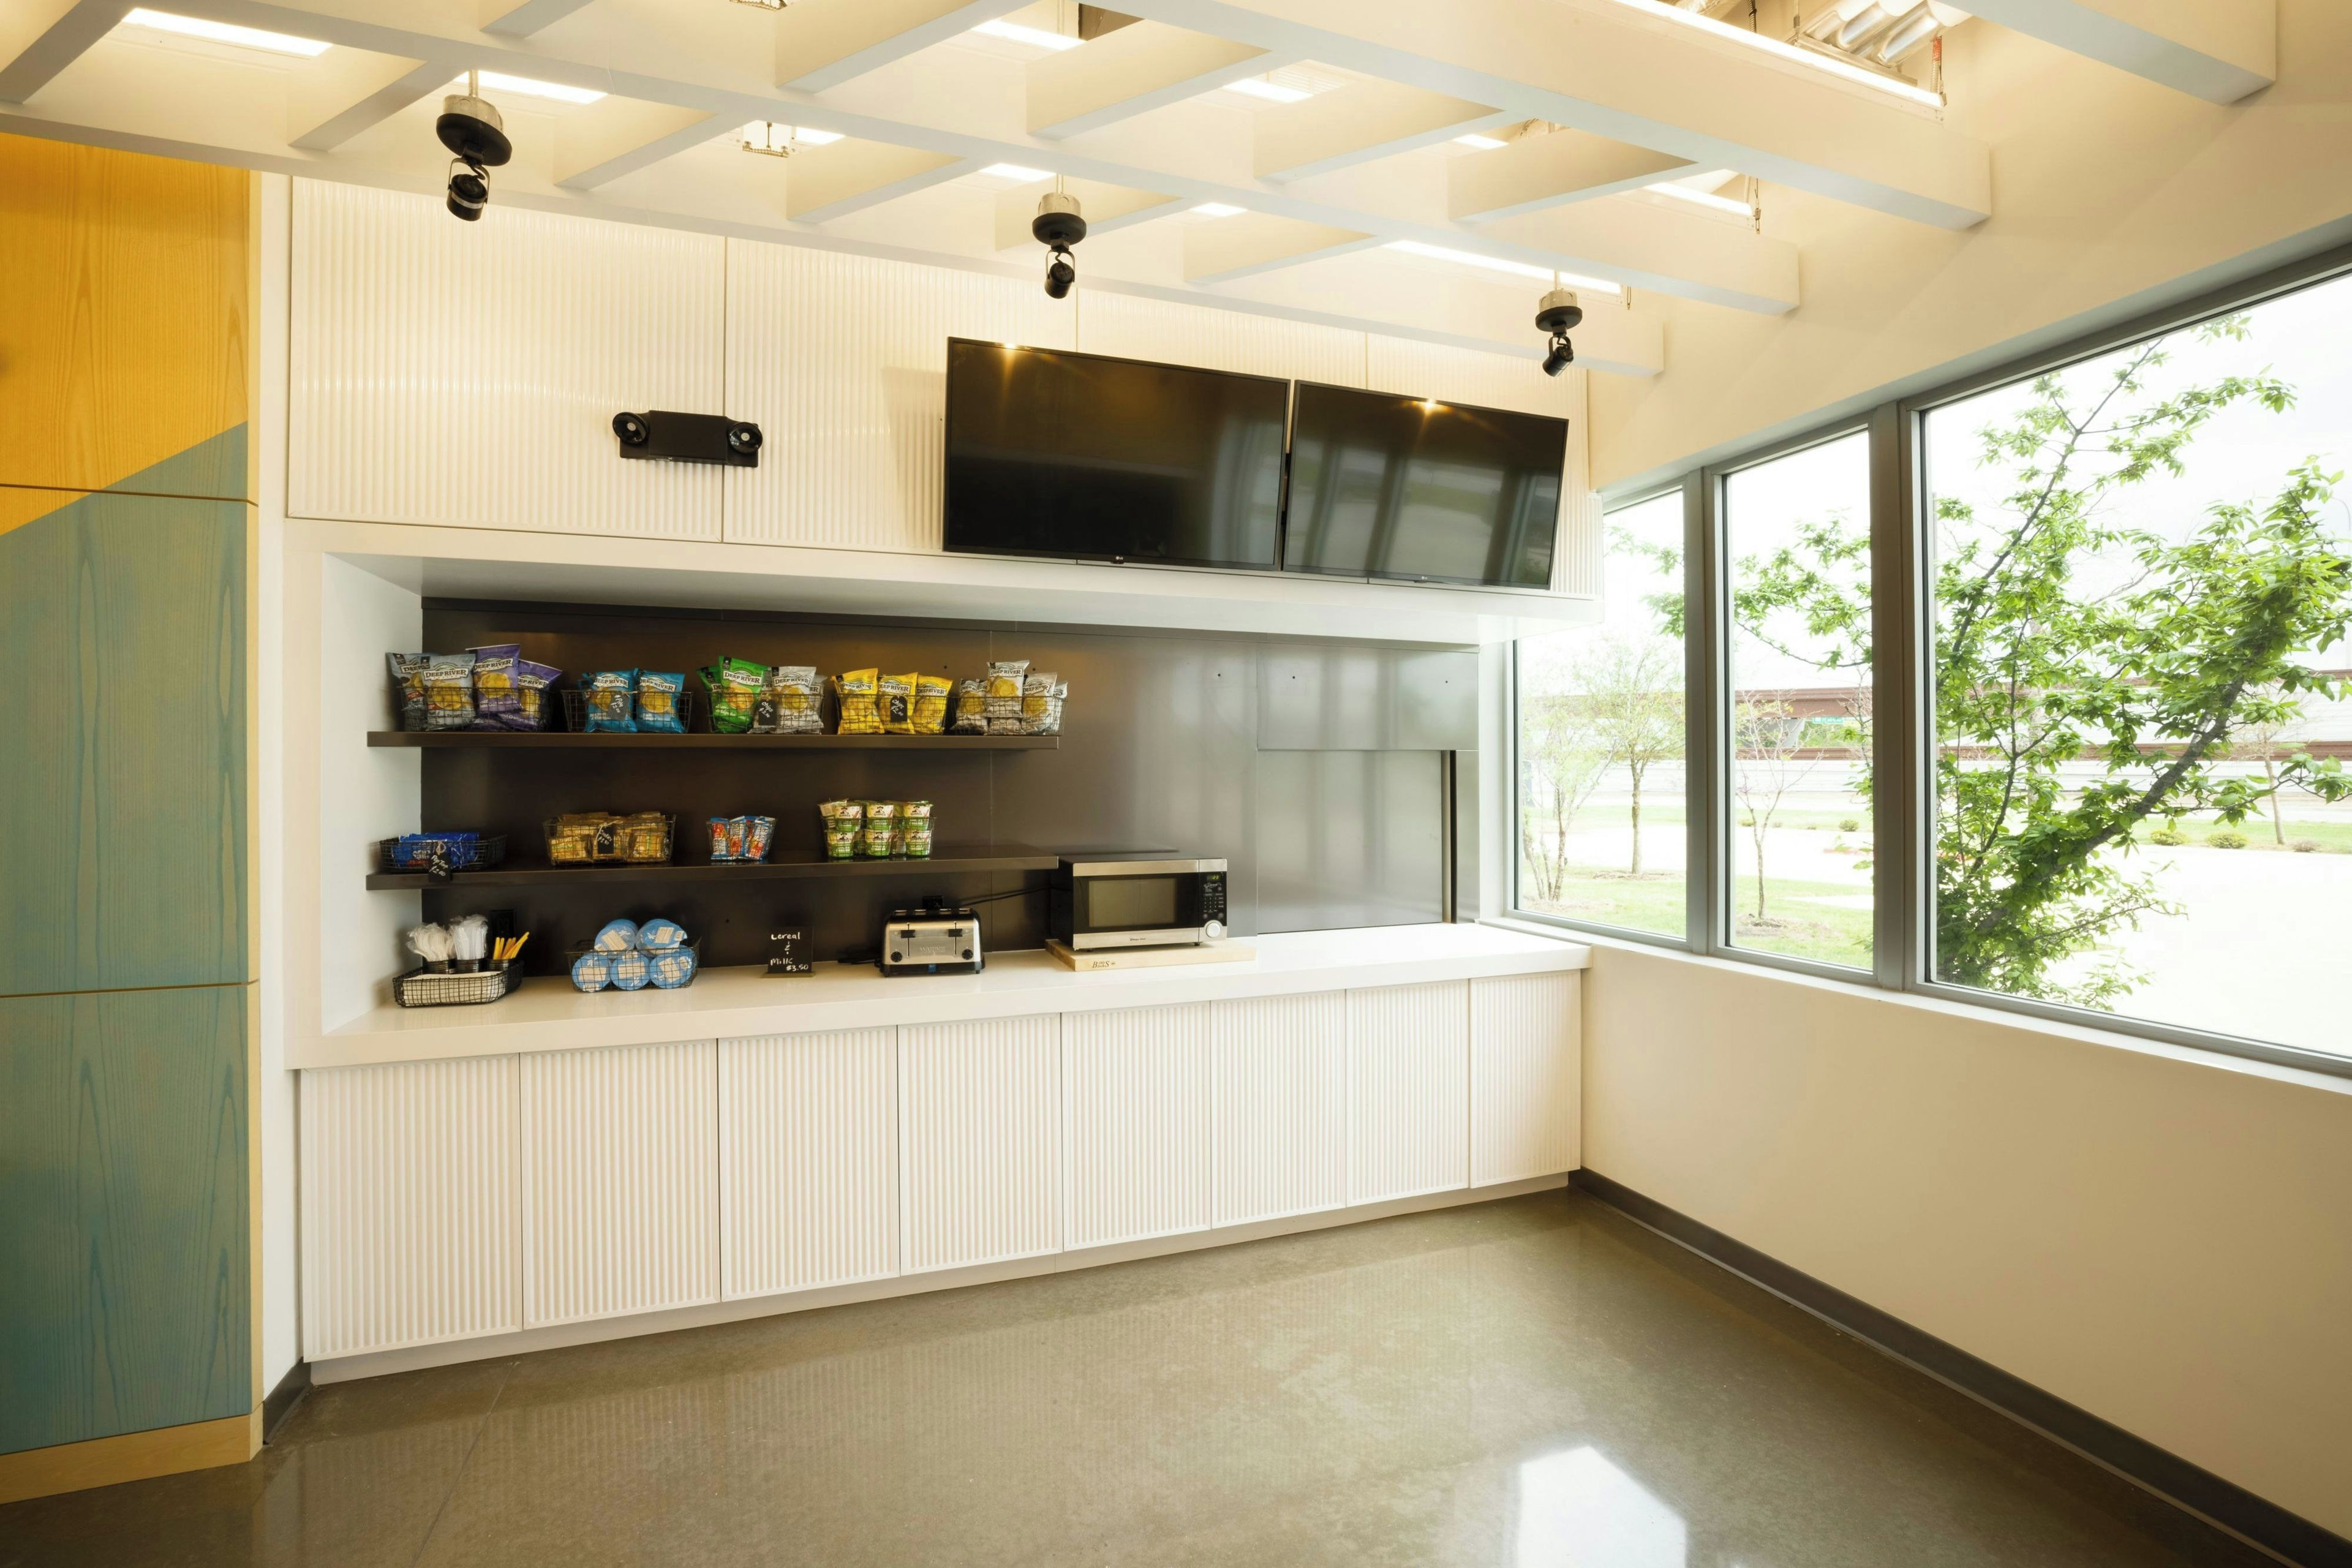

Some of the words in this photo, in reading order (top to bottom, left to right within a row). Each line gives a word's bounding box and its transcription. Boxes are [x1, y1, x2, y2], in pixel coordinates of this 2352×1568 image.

[473, 663, 490, 671] DEEP
[491, 659, 511, 668] RIVER
[609, 678, 628, 687] RIVER
[741, 676, 760, 684] RIVER
[654, 682, 674, 692] RIVER
